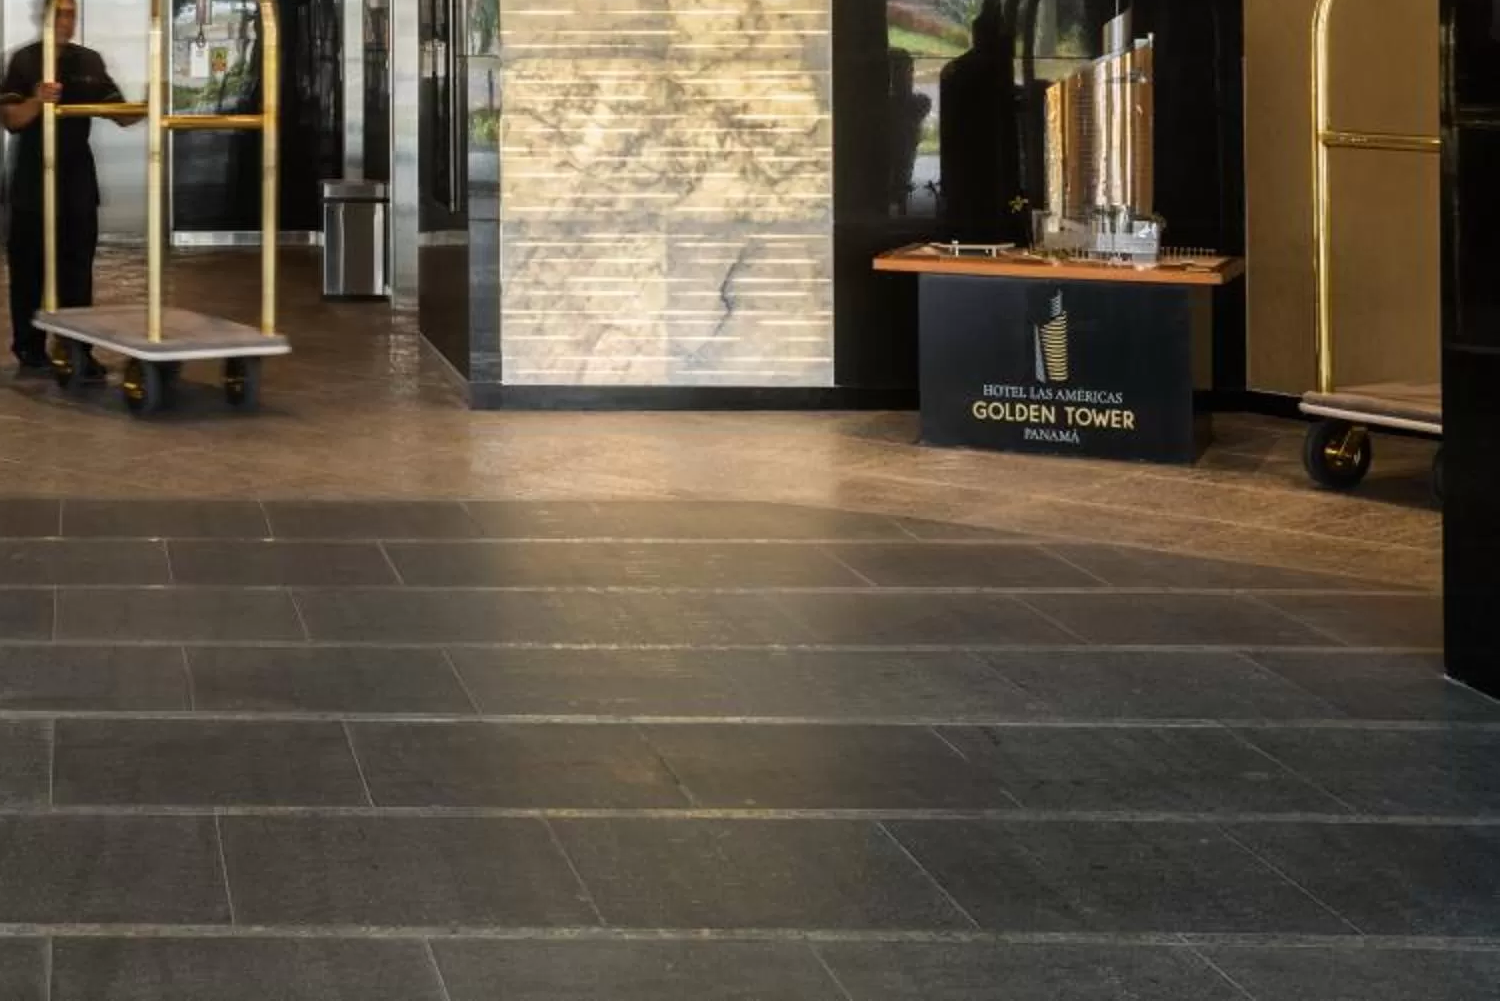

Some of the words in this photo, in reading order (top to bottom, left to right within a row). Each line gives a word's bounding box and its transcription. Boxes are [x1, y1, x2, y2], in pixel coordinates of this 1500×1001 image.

[983, 384, 1027, 398] HOTEL
[1030, 386, 1053, 399] LAS
[1055, 387, 1123, 403] AMÉRICAS
[972, 401, 1056, 423] GOLDEN
[1064, 406, 1135, 429] TOWER
[1023, 427, 1080, 443] PANAMÁ
